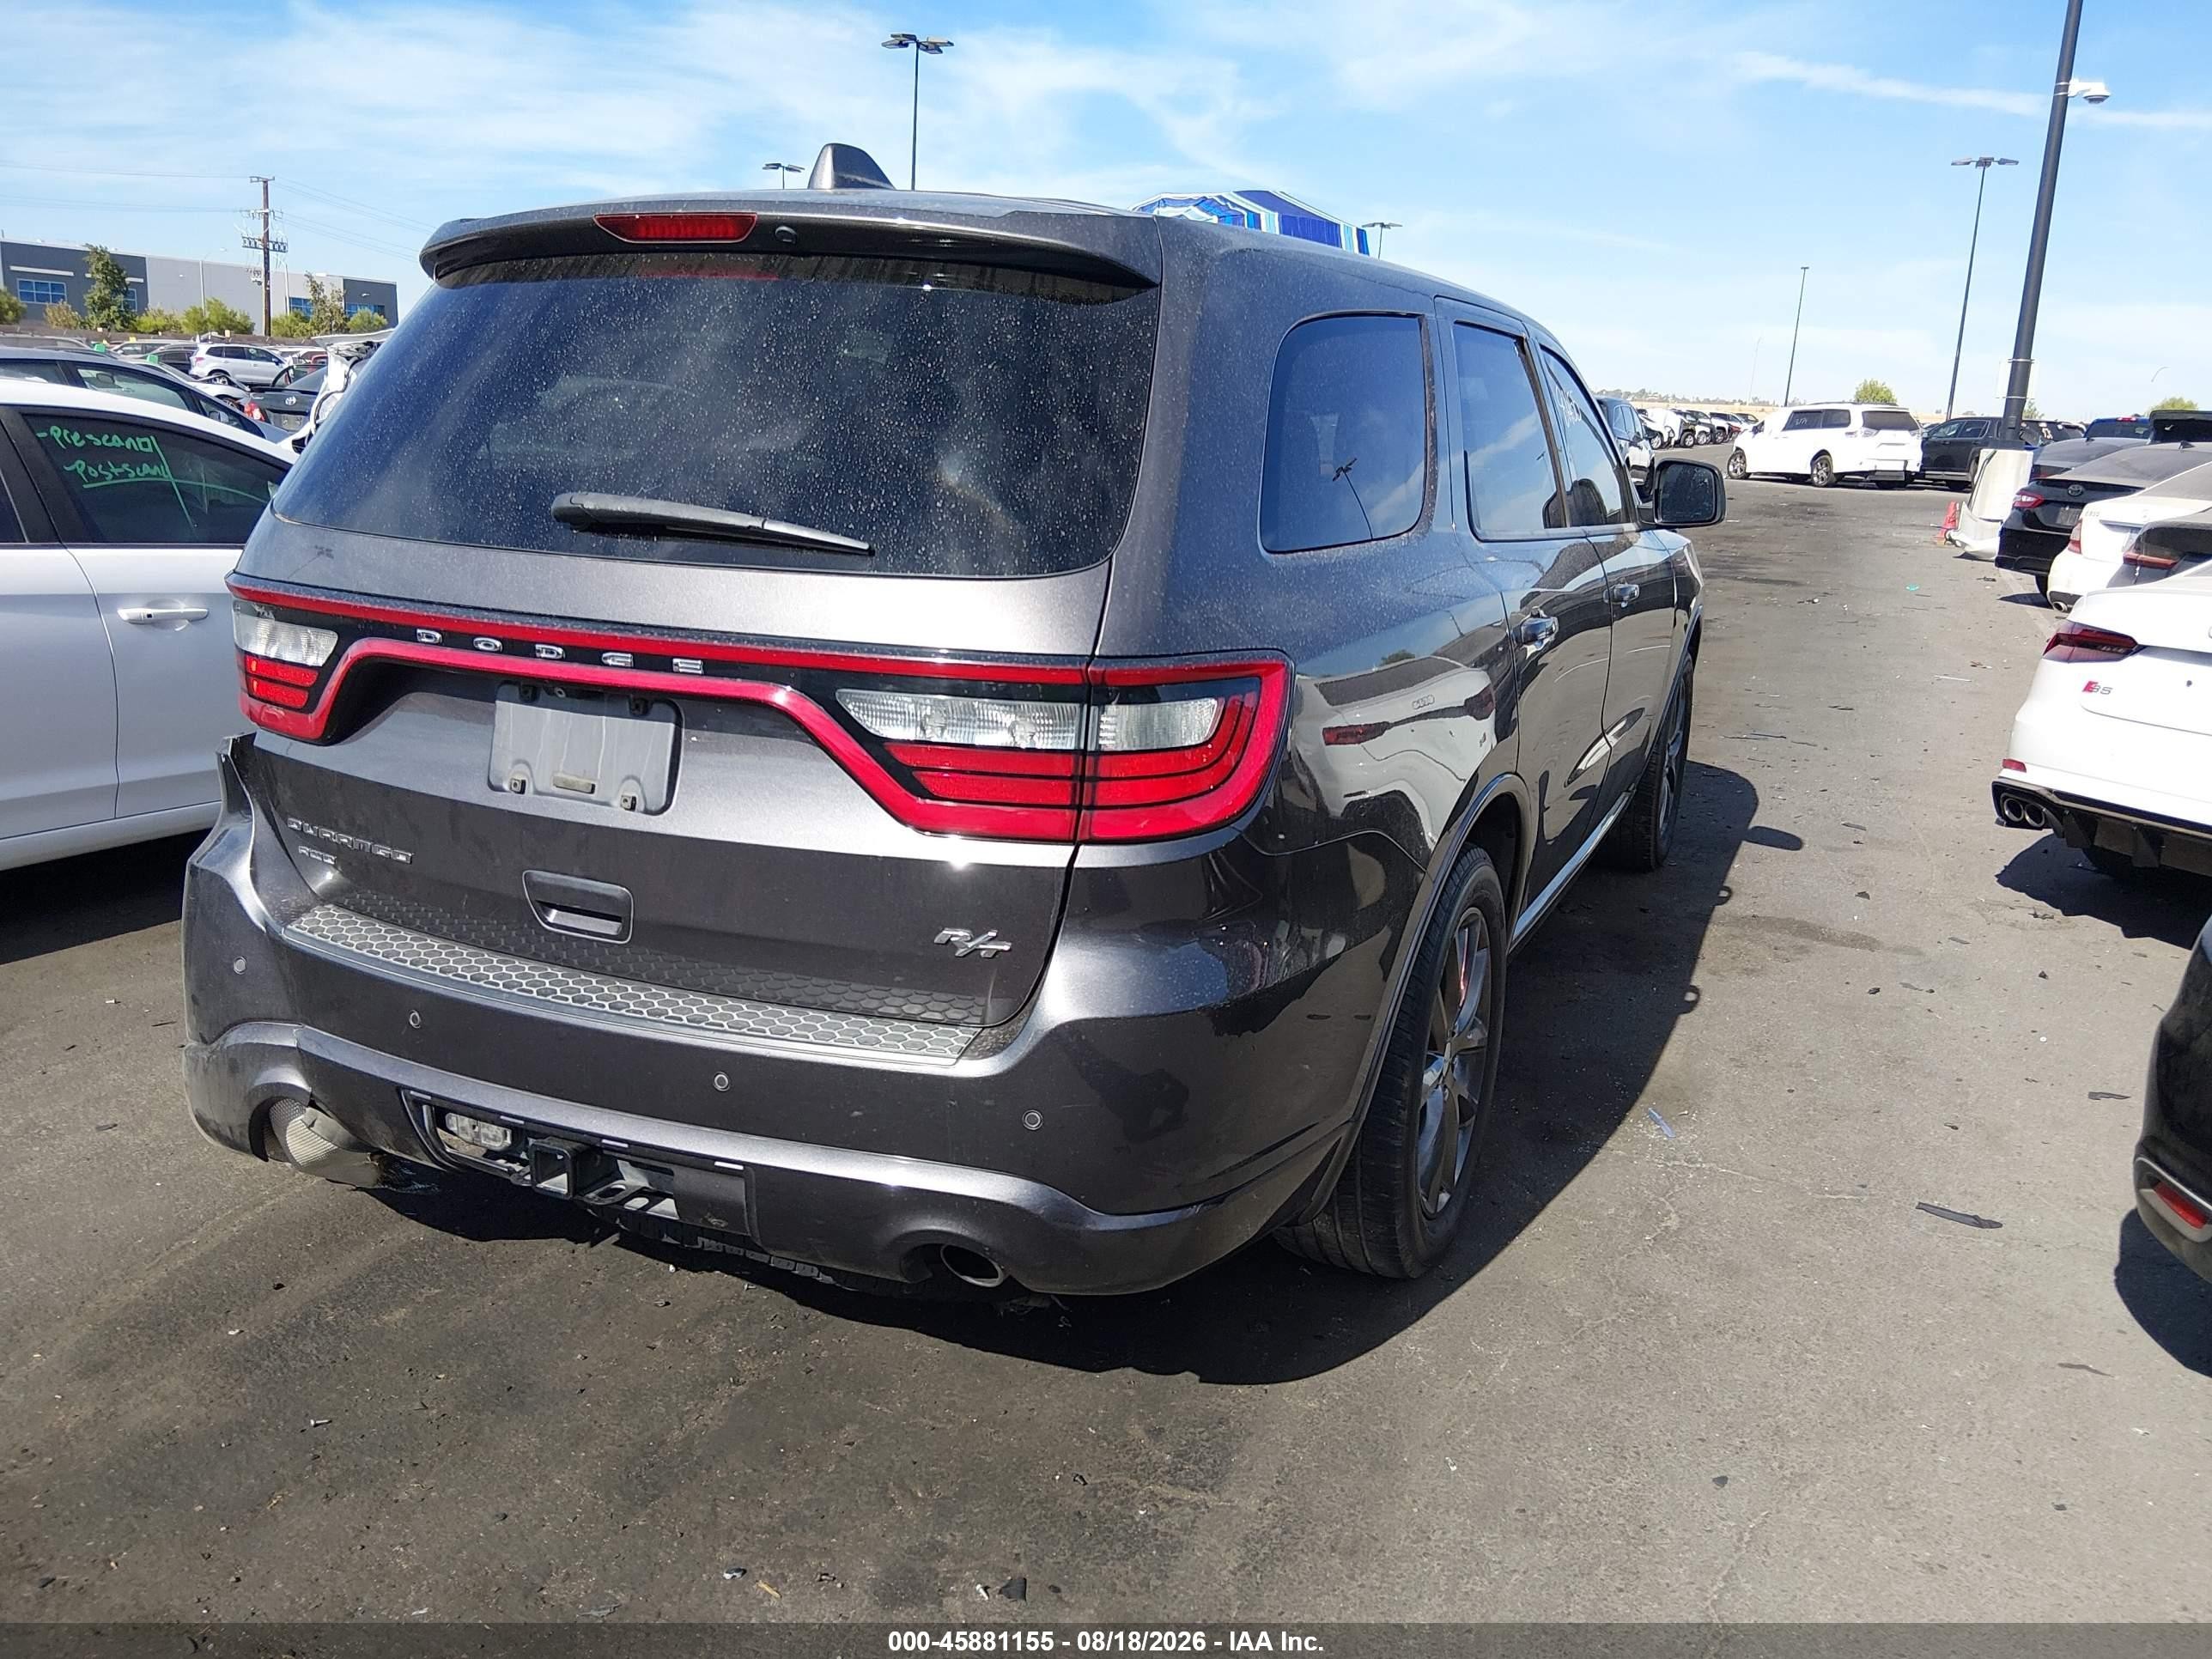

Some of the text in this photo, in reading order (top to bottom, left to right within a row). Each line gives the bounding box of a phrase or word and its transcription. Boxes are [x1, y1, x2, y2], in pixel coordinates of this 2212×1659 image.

[416, 628, 705, 676] DODGE
[287, 817, 414, 865] DURANGO
[933, 927, 1012, 958] R/T
